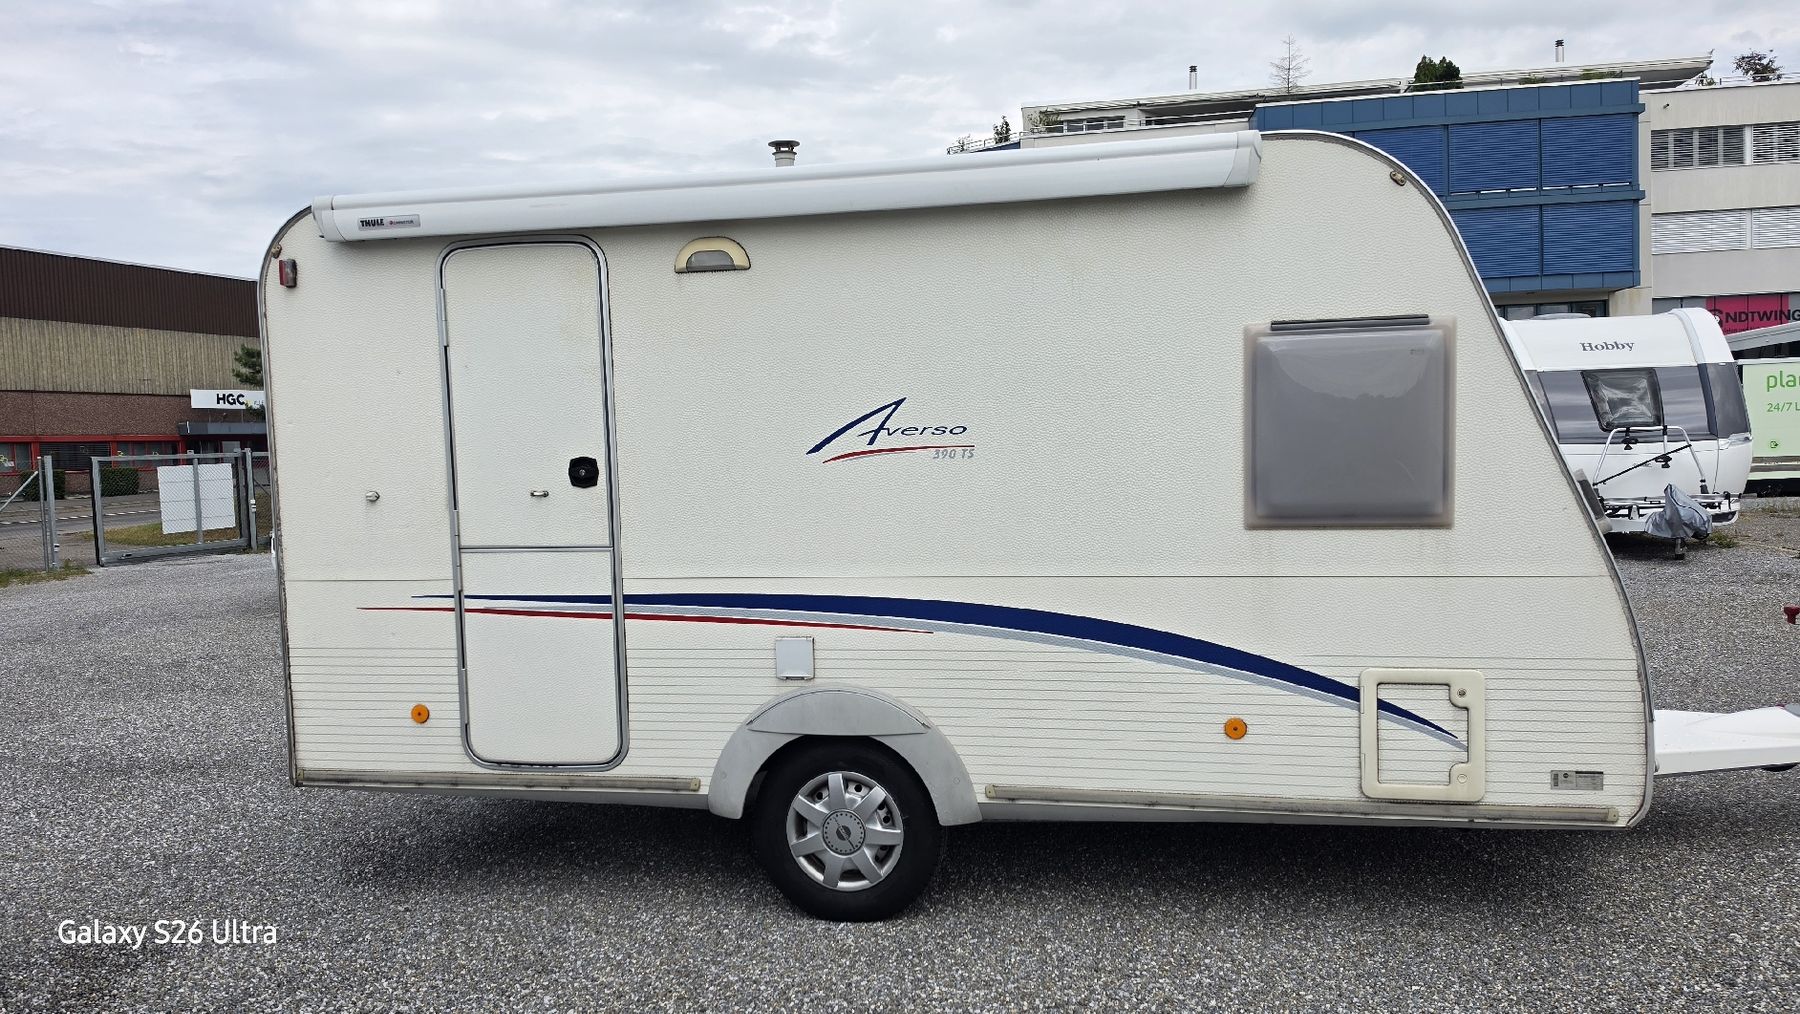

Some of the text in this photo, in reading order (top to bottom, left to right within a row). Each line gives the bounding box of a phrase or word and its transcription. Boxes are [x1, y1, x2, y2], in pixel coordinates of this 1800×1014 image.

[360, 218, 385, 227] THULE
[1709, 308, 1800, 326] NDTWING
[1579, 341, 1635, 352] Hobby
[1766, 370, 1800, 392] pla
[216, 393, 246, 406] HGC
[1766, 402, 1793, 412] 24/7
[805, 396, 968, 455] Averso
[932, 448, 976, 459] 390 TS
